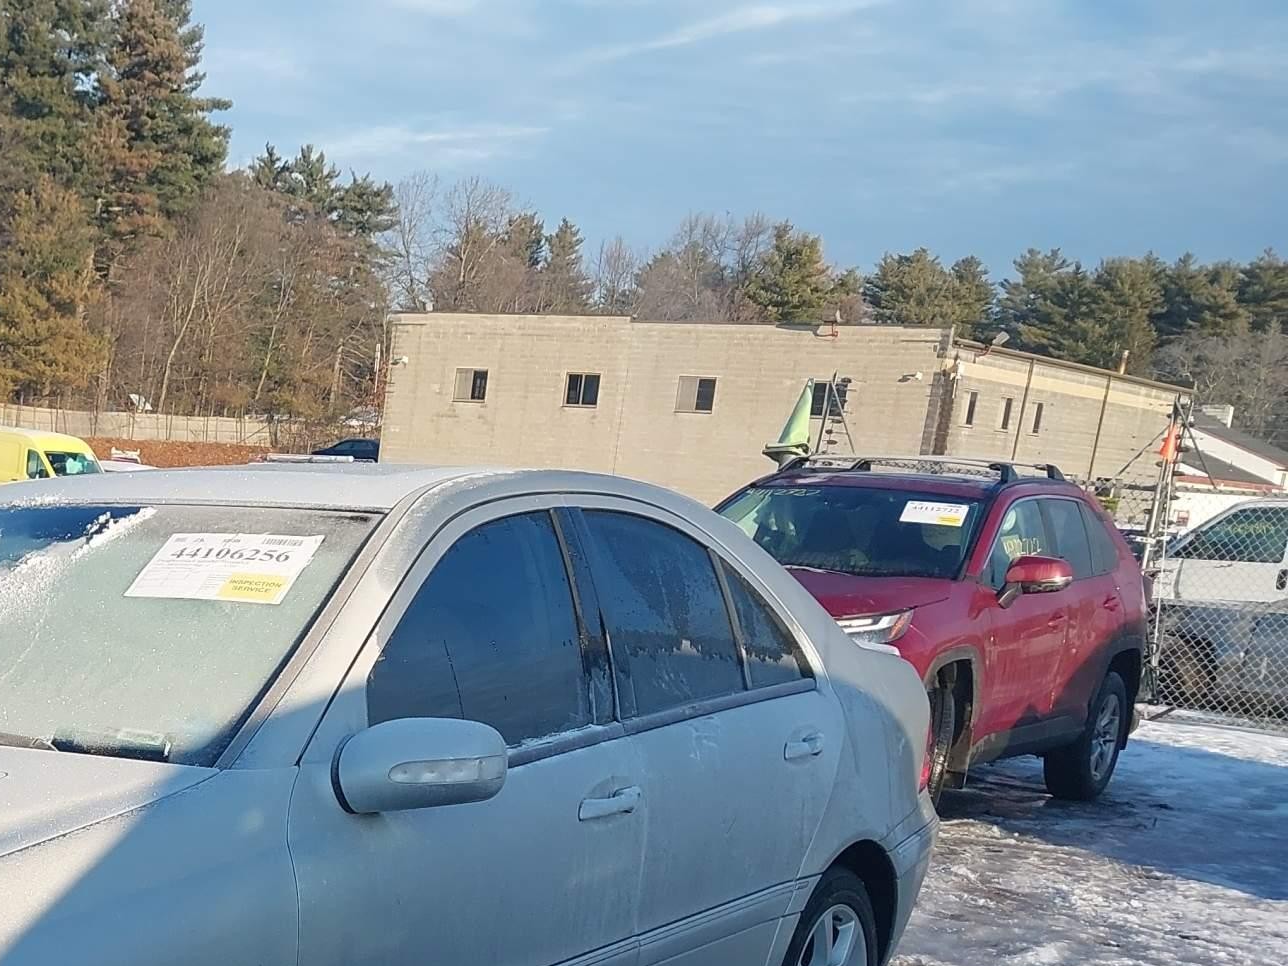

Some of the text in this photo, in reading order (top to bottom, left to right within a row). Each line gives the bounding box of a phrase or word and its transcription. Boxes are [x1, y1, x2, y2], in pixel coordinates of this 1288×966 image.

[170, 547, 292, 563] 44106256
[229, 579, 283, 589] INSPECTION
[231, 585, 272, 593] SERVICE
